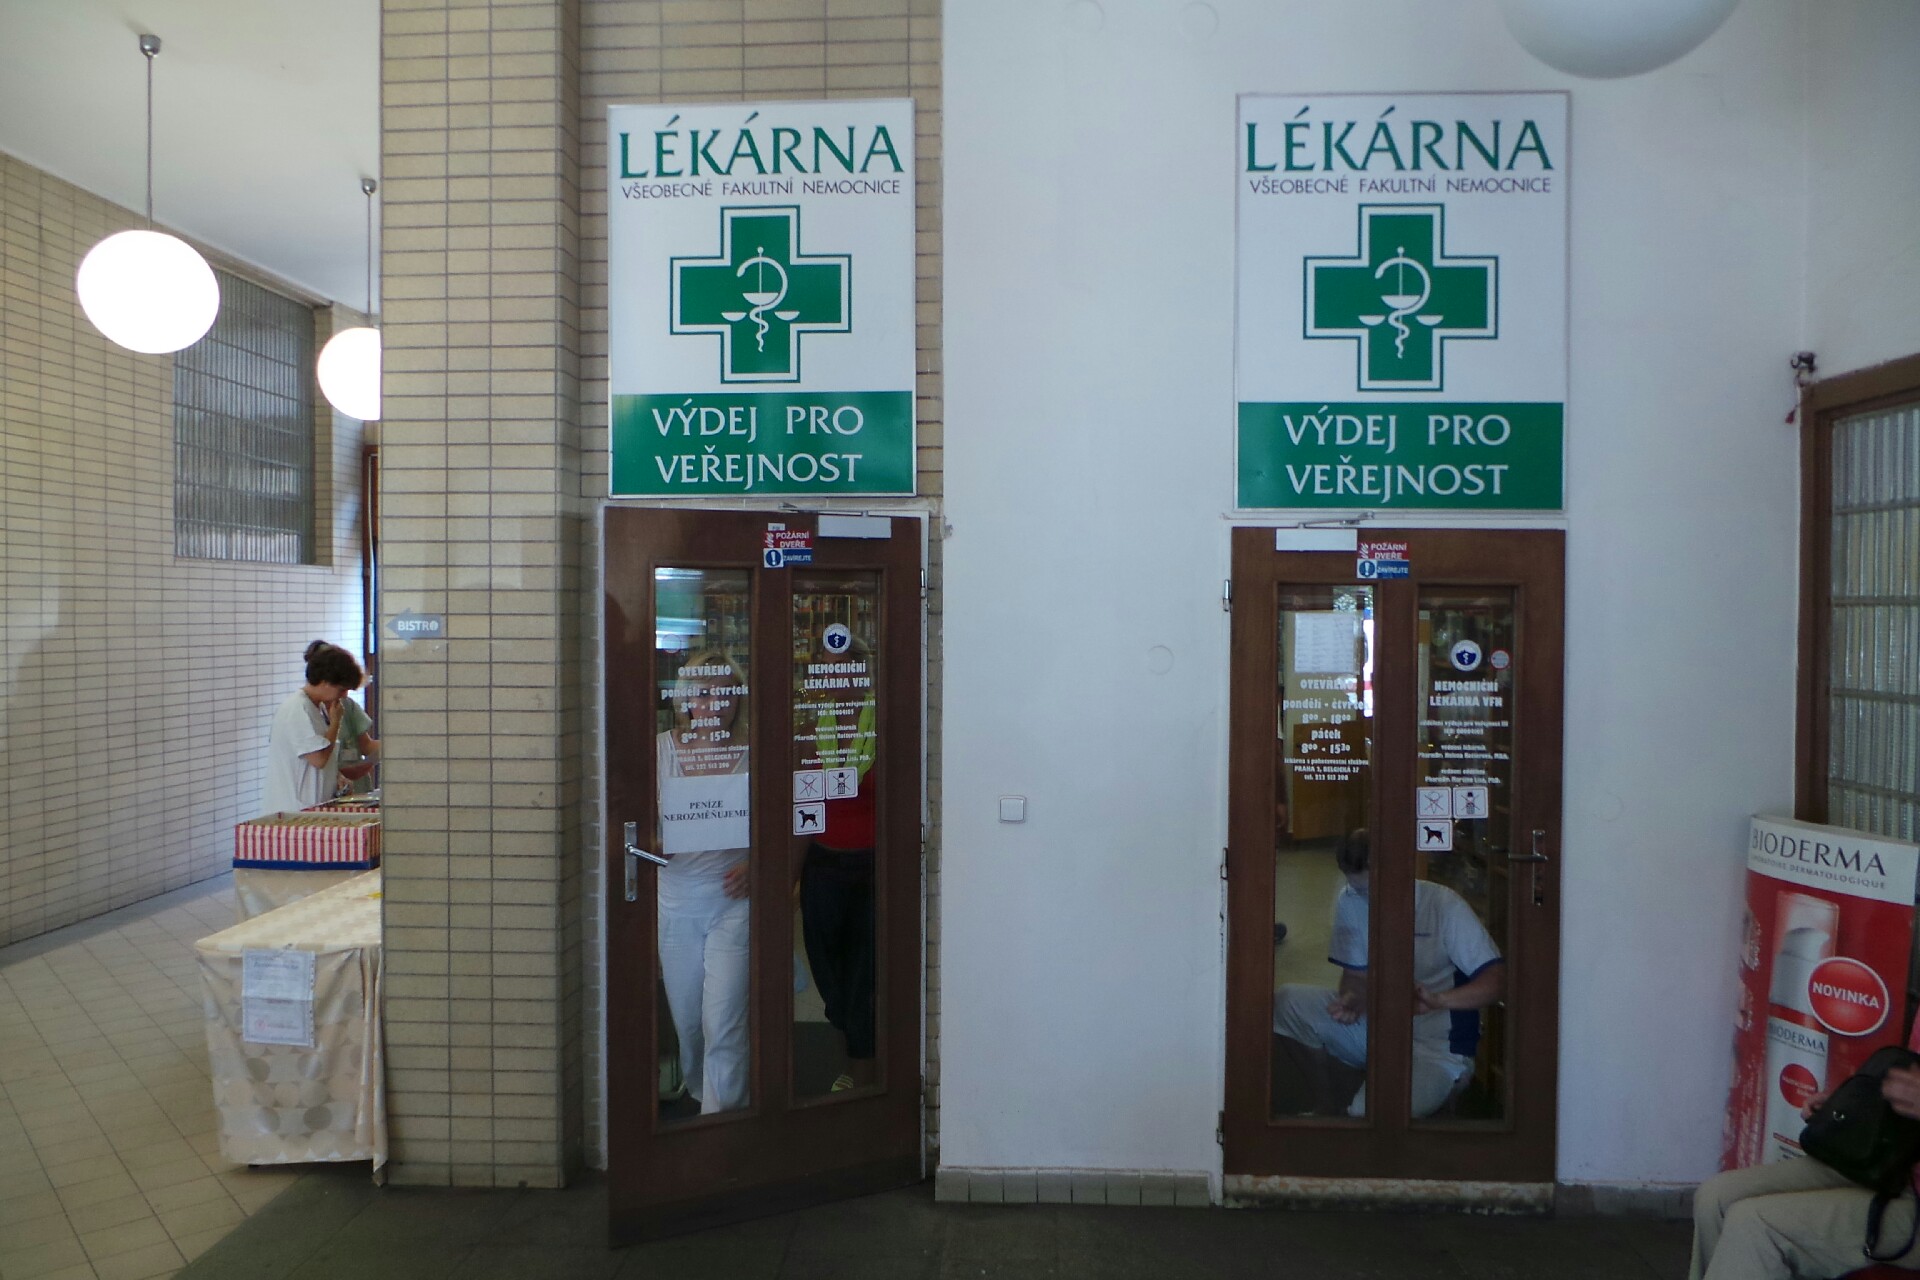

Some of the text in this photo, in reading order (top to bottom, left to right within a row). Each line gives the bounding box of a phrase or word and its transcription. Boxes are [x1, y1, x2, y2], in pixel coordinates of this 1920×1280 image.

[620, 111, 905, 178] LÉKÁRNA
[1246, 105, 1554, 172] LÉKÁRNA
[622, 177, 901, 199] VŠEOBECNÉ FAKULTNÍ NEMOCNICE
[1250, 174, 1551, 194] VŠEOBECNÉ FAKULTNÍ NEMOCNICE
[652, 398, 864, 443] VÝDEJ PRO
[1283, 405, 1511, 454] VÝDEJ PRO
[655, 445, 863, 490] VEŘEJNOST
[1286, 455, 1509, 503] VEŘEJNOST
[776, 531, 810, 540] POŽÁRNÍ
[780, 540, 806, 548] DVEŘE
[1371, 542, 1407, 551] POŽÁRNÍ
[398, 620, 439, 631] BISTRO
[678, 663, 731, 677] OTEVŘENO
[808, 660, 866, 674] NEMOCNIČNÍ
[804, 676, 871, 689] LÉKÁRNA VFN
[1434, 678, 1499, 692] NEMOCNIČNÍ
[661, 686, 701, 700] pondělí
[710, 685, 749, 696] čtvrtek
[1283, 698, 1322, 710] pondělí
[1430, 693, 1503, 707] LÉKÁRNA VFN
[691, 716, 721, 730] pátek
[1312, 728, 1341, 741] pátek
[690, 799, 724, 810] PENÍZE
[664, 810, 749, 821] NEROZMĚŇUJEME
[1753, 828, 1886, 876] BIODERMA
[1790, 864, 1886, 889] DERMATOLOGIQUE
[1813, 982, 1880, 1009] NOVINKA
